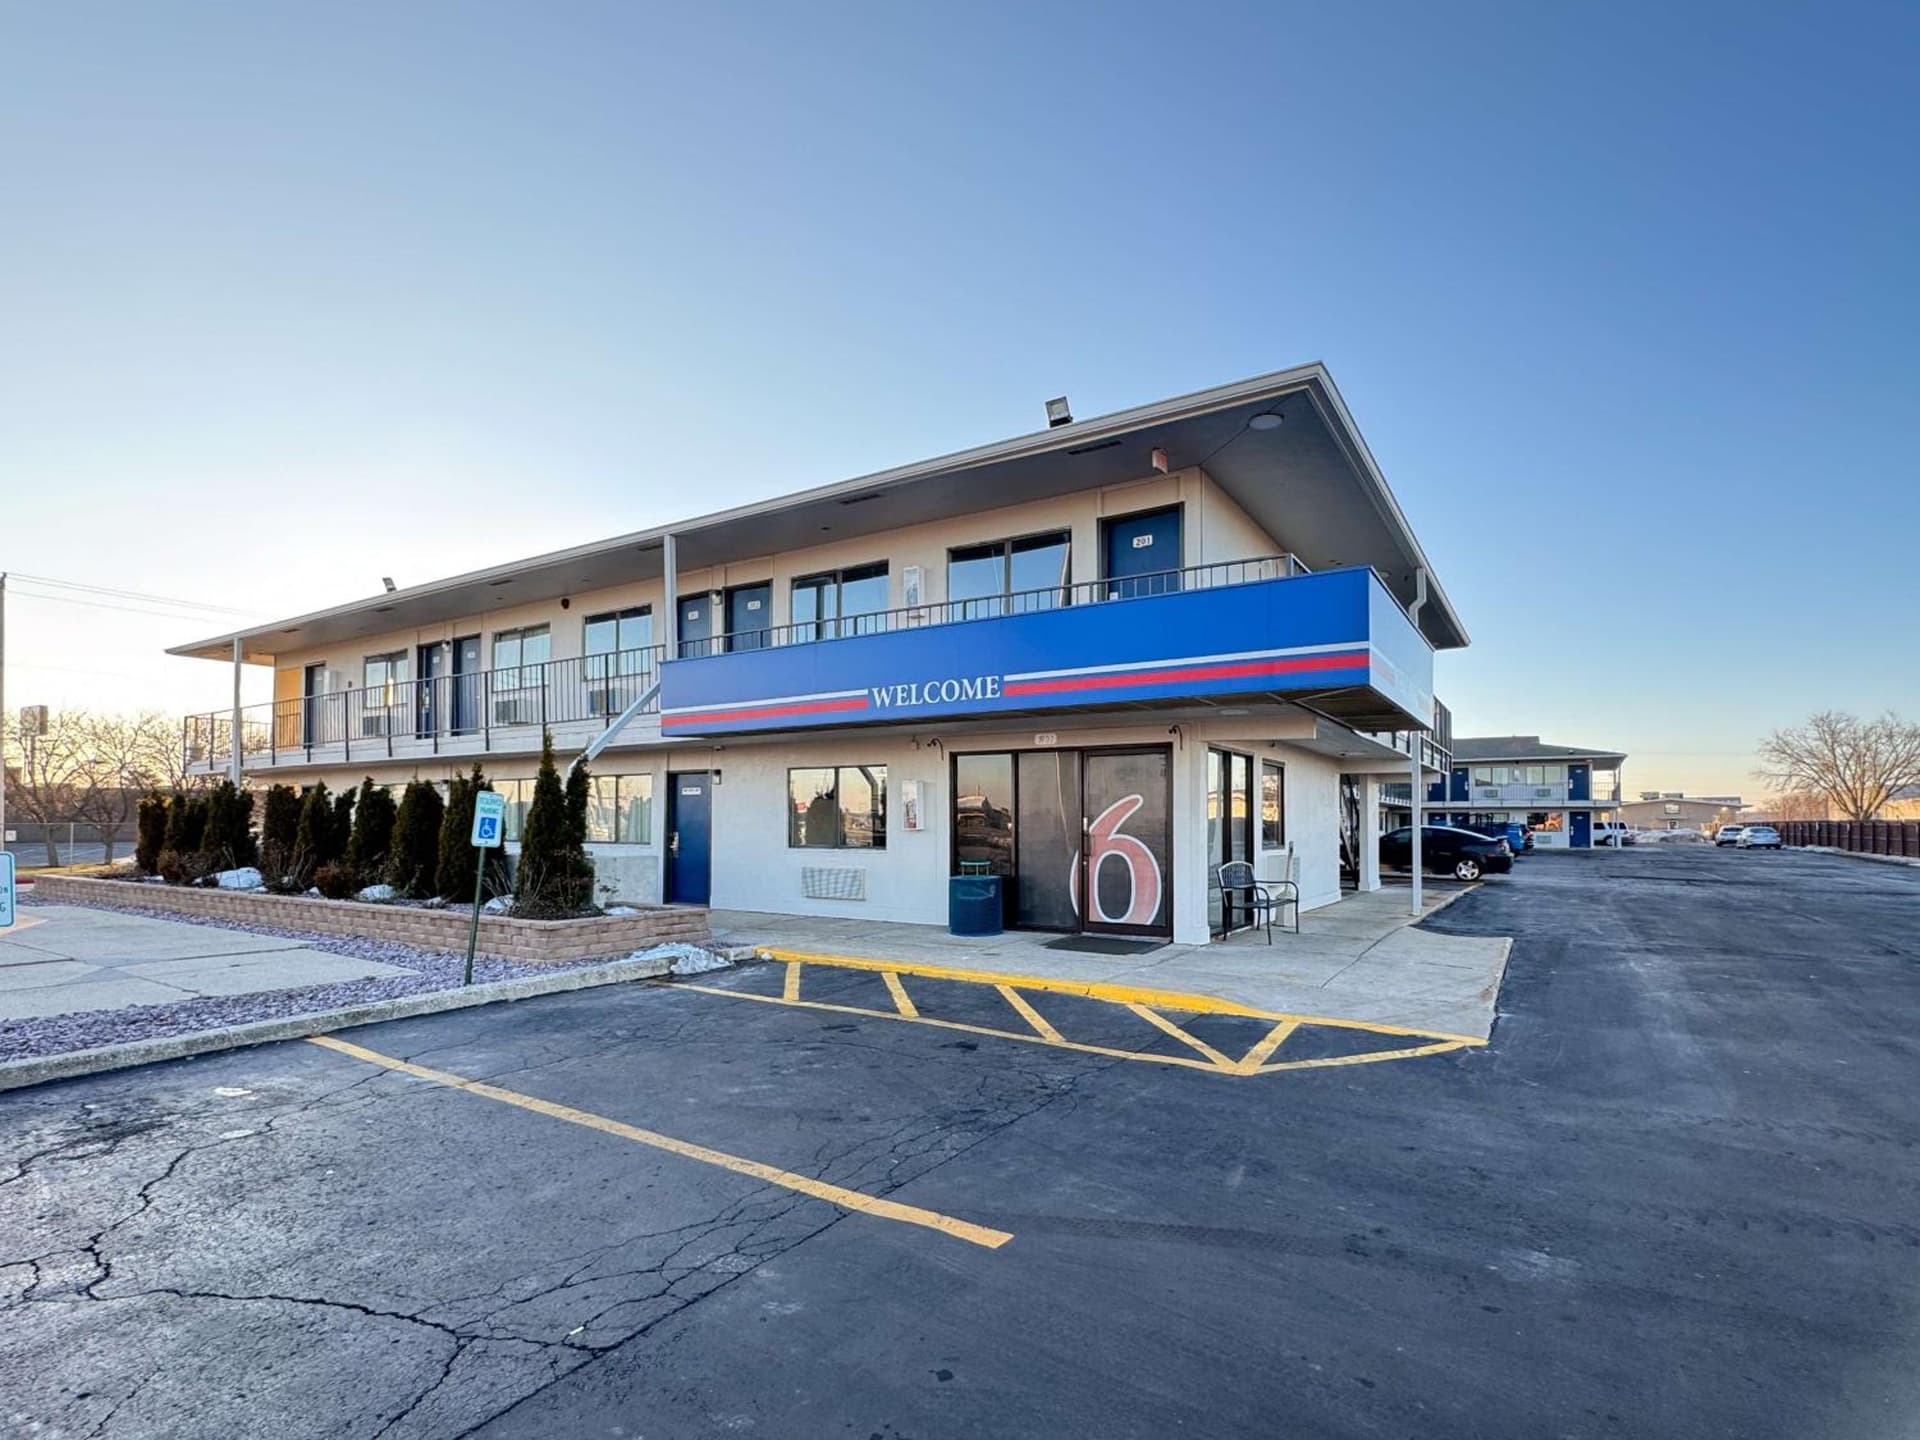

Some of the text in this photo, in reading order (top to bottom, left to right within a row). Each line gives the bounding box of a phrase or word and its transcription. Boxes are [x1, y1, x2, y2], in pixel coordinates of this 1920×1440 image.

[1135, 536, 1150, 546] 201
[871, 675, 1001, 709] WELCOME
[1070, 794, 1162, 926] 6
